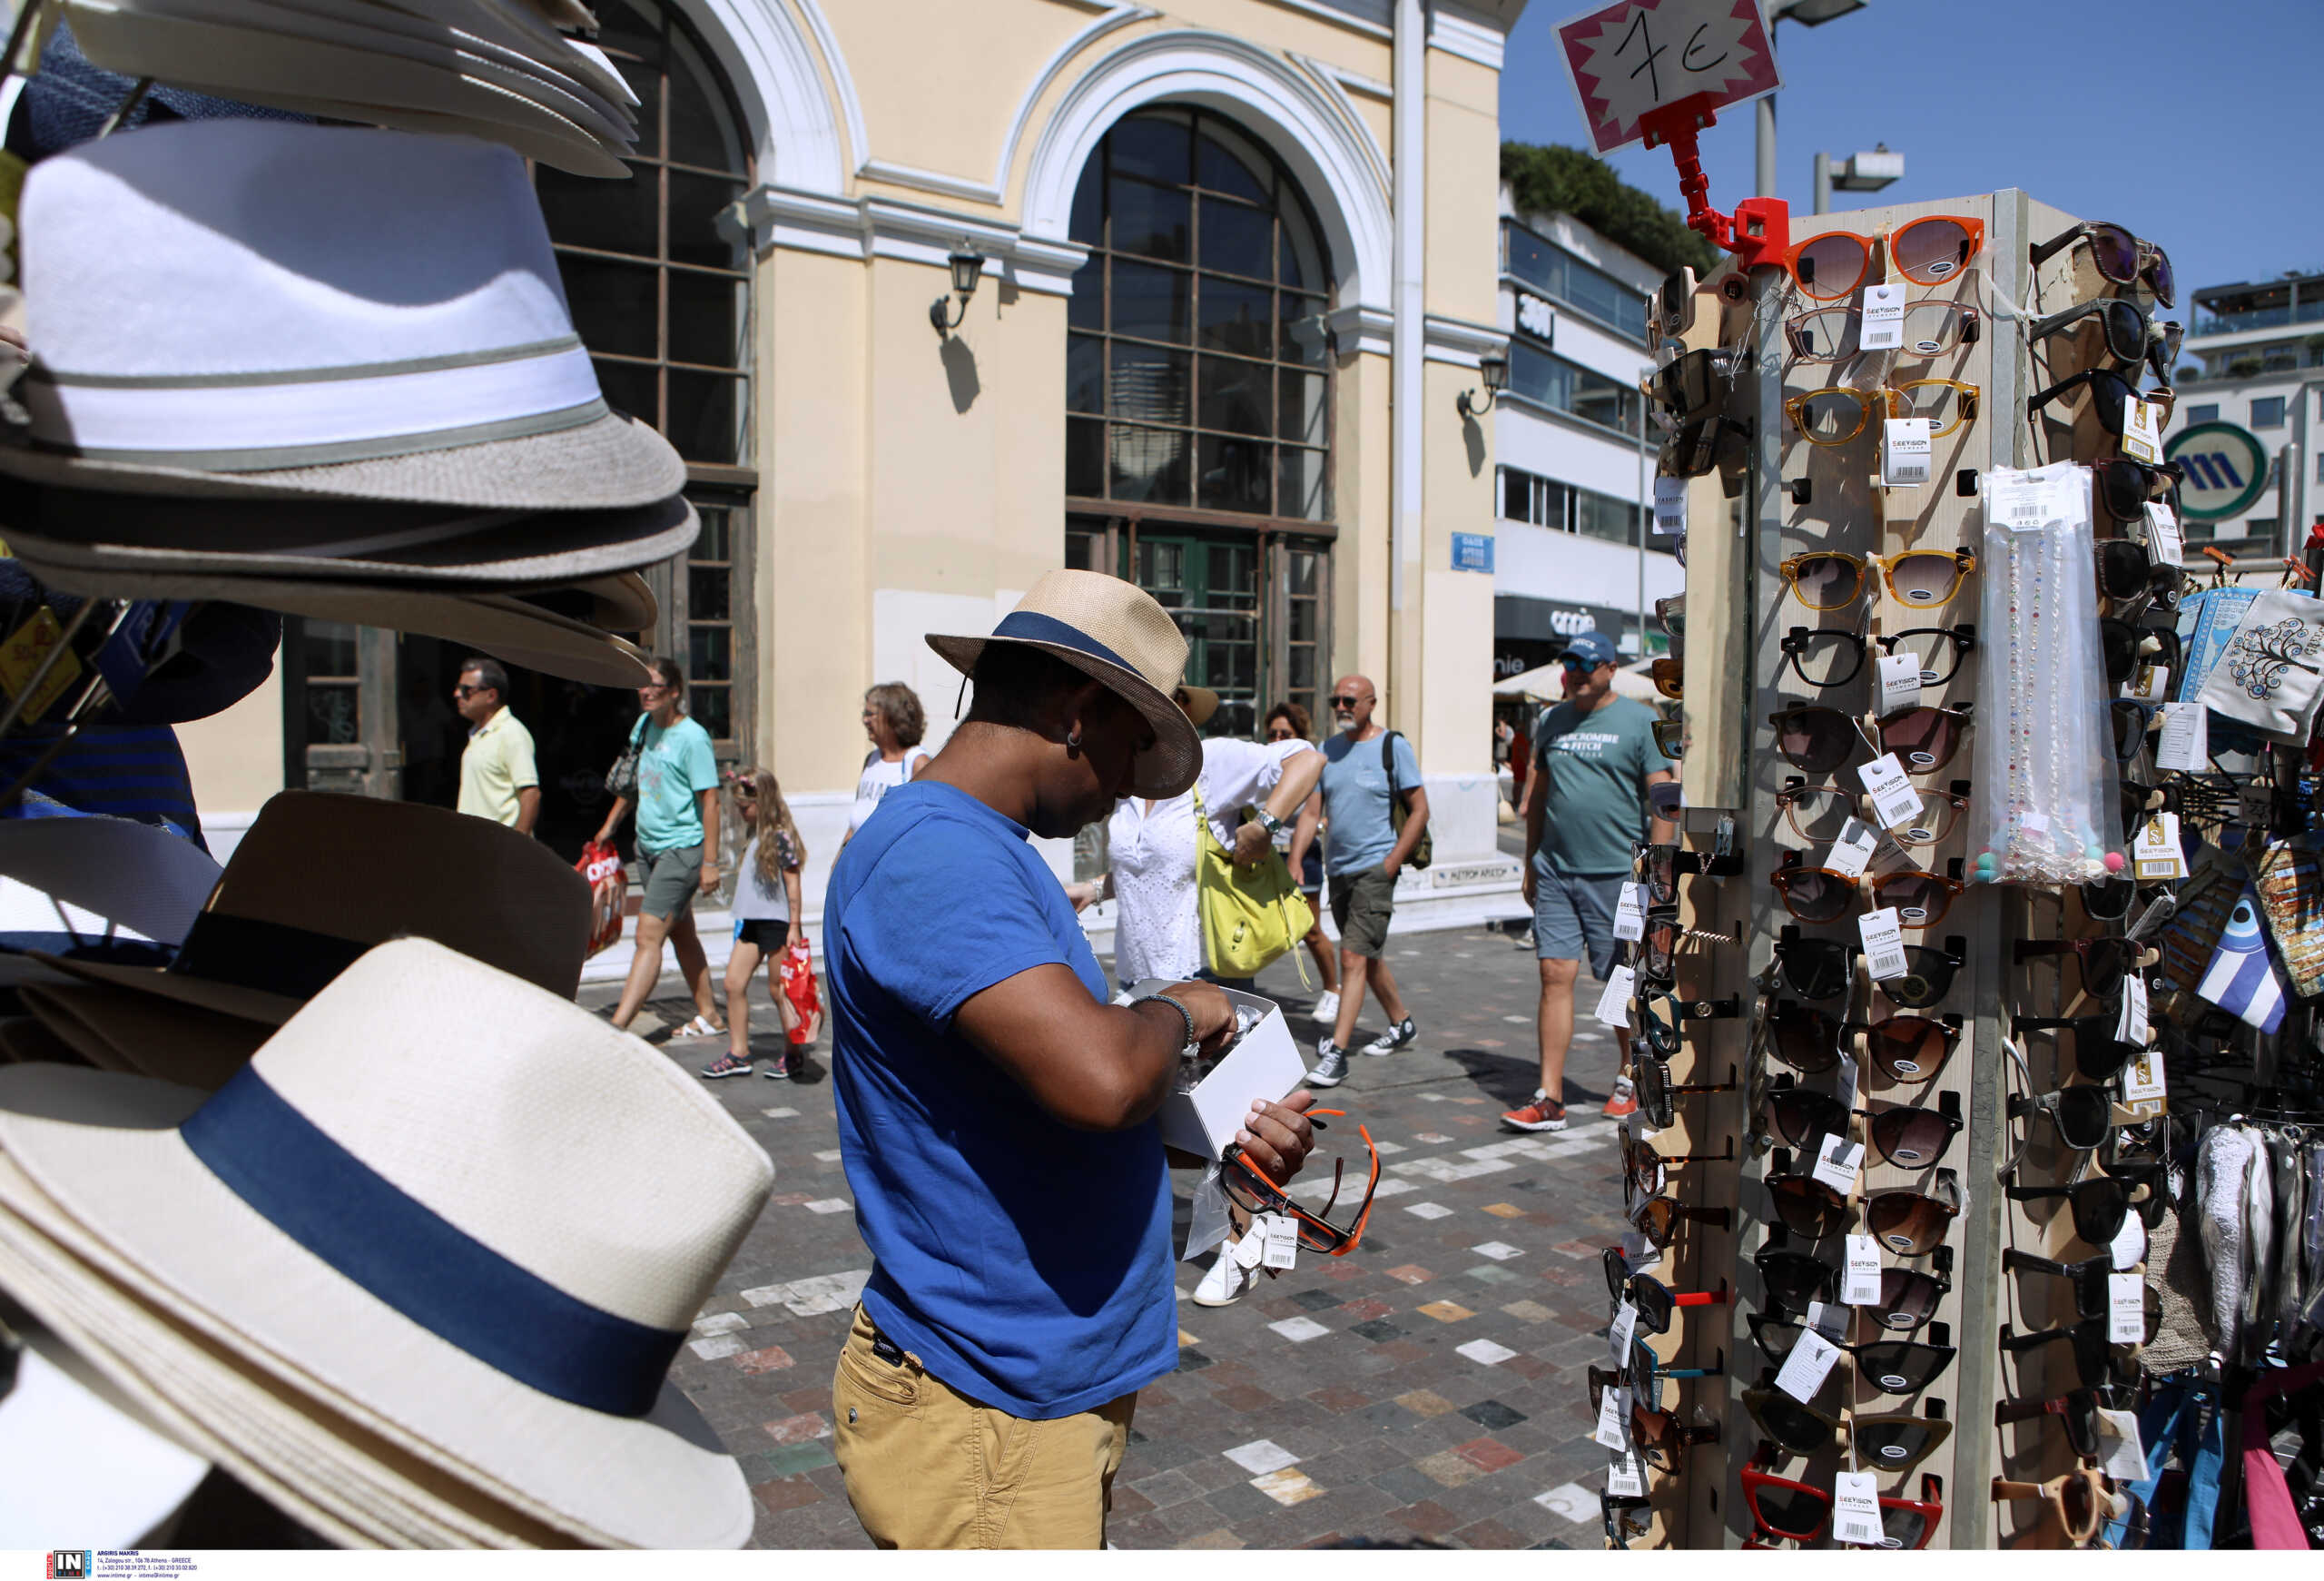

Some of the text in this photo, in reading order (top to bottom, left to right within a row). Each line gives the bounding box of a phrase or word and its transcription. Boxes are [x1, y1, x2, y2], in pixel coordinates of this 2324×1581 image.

[1866, 306, 1901, 314] SEEVISION
[1886, 677, 1917, 687] SEEVISION
[1872, 775, 1904, 794] SEEVISION
[1866, 929, 1896, 942] SEEVISION
[1850, 1260, 1878, 1268] SEEVISION
[1838, 1496, 1873, 1505] SEEVISION
